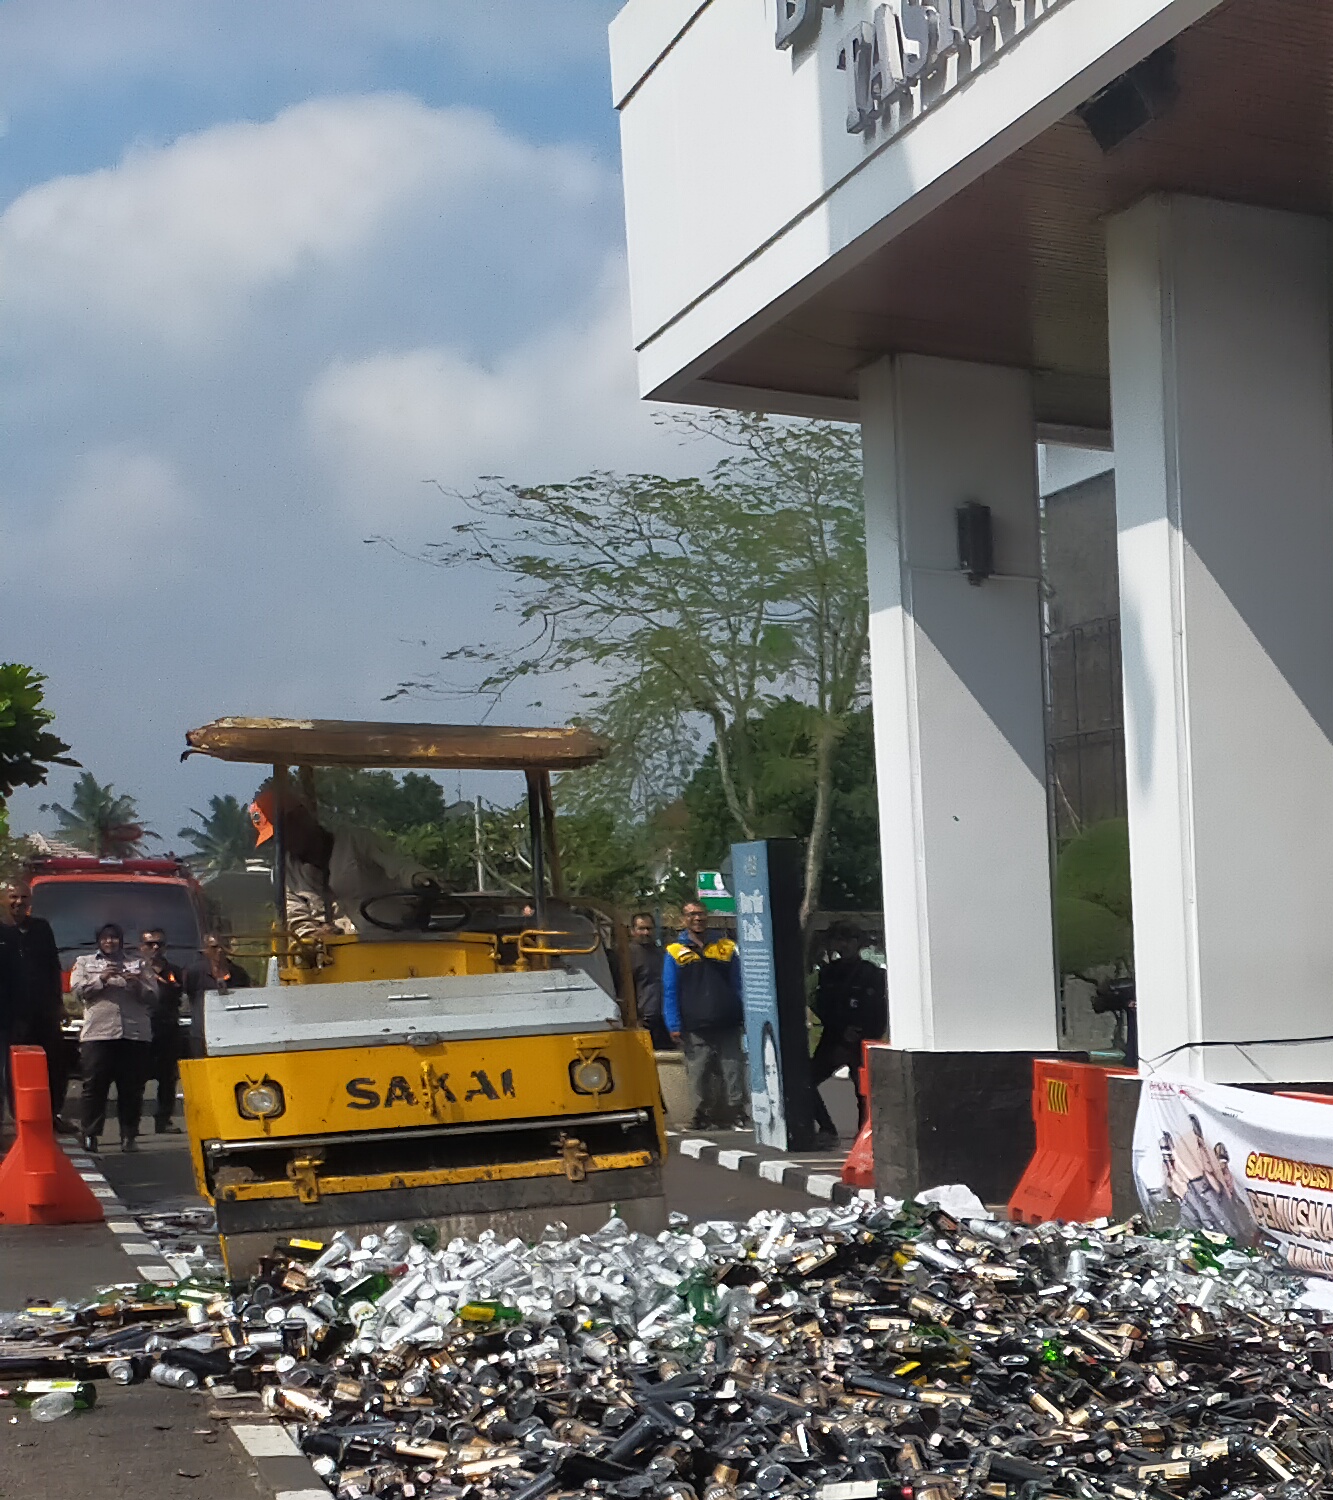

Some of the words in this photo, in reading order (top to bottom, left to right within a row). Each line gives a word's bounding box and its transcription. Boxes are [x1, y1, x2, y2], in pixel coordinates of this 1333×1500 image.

[346, 1068, 516, 1110] SAKAI
[1246, 1152, 1297, 1185] SATUAN
[1293, 1161, 1332, 1191] POLISI
